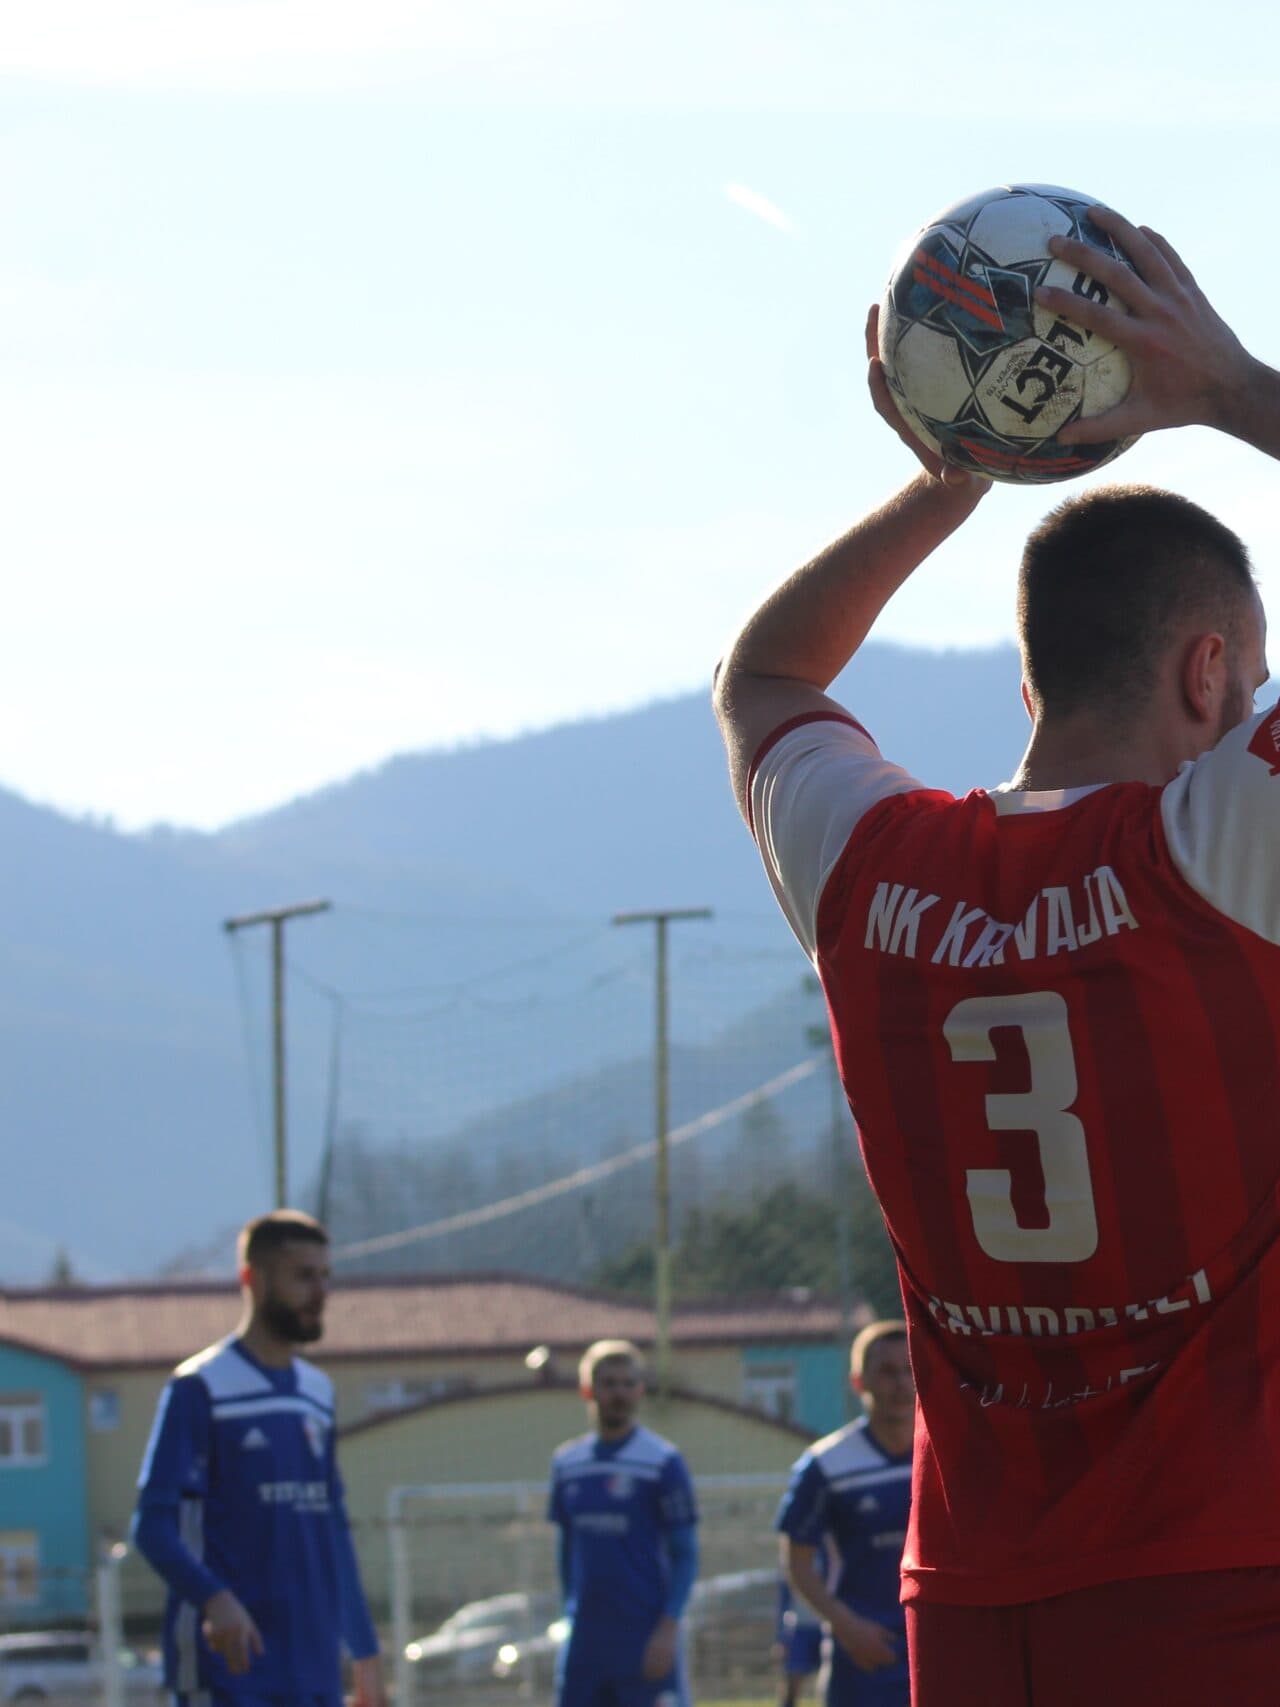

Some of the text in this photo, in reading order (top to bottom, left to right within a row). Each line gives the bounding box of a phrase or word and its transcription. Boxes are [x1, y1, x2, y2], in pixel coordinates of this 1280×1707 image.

[1000, 271, 1109, 424] SLECT
[864, 881, 941, 959] NK
[942, 990, 1098, 1263] 3
